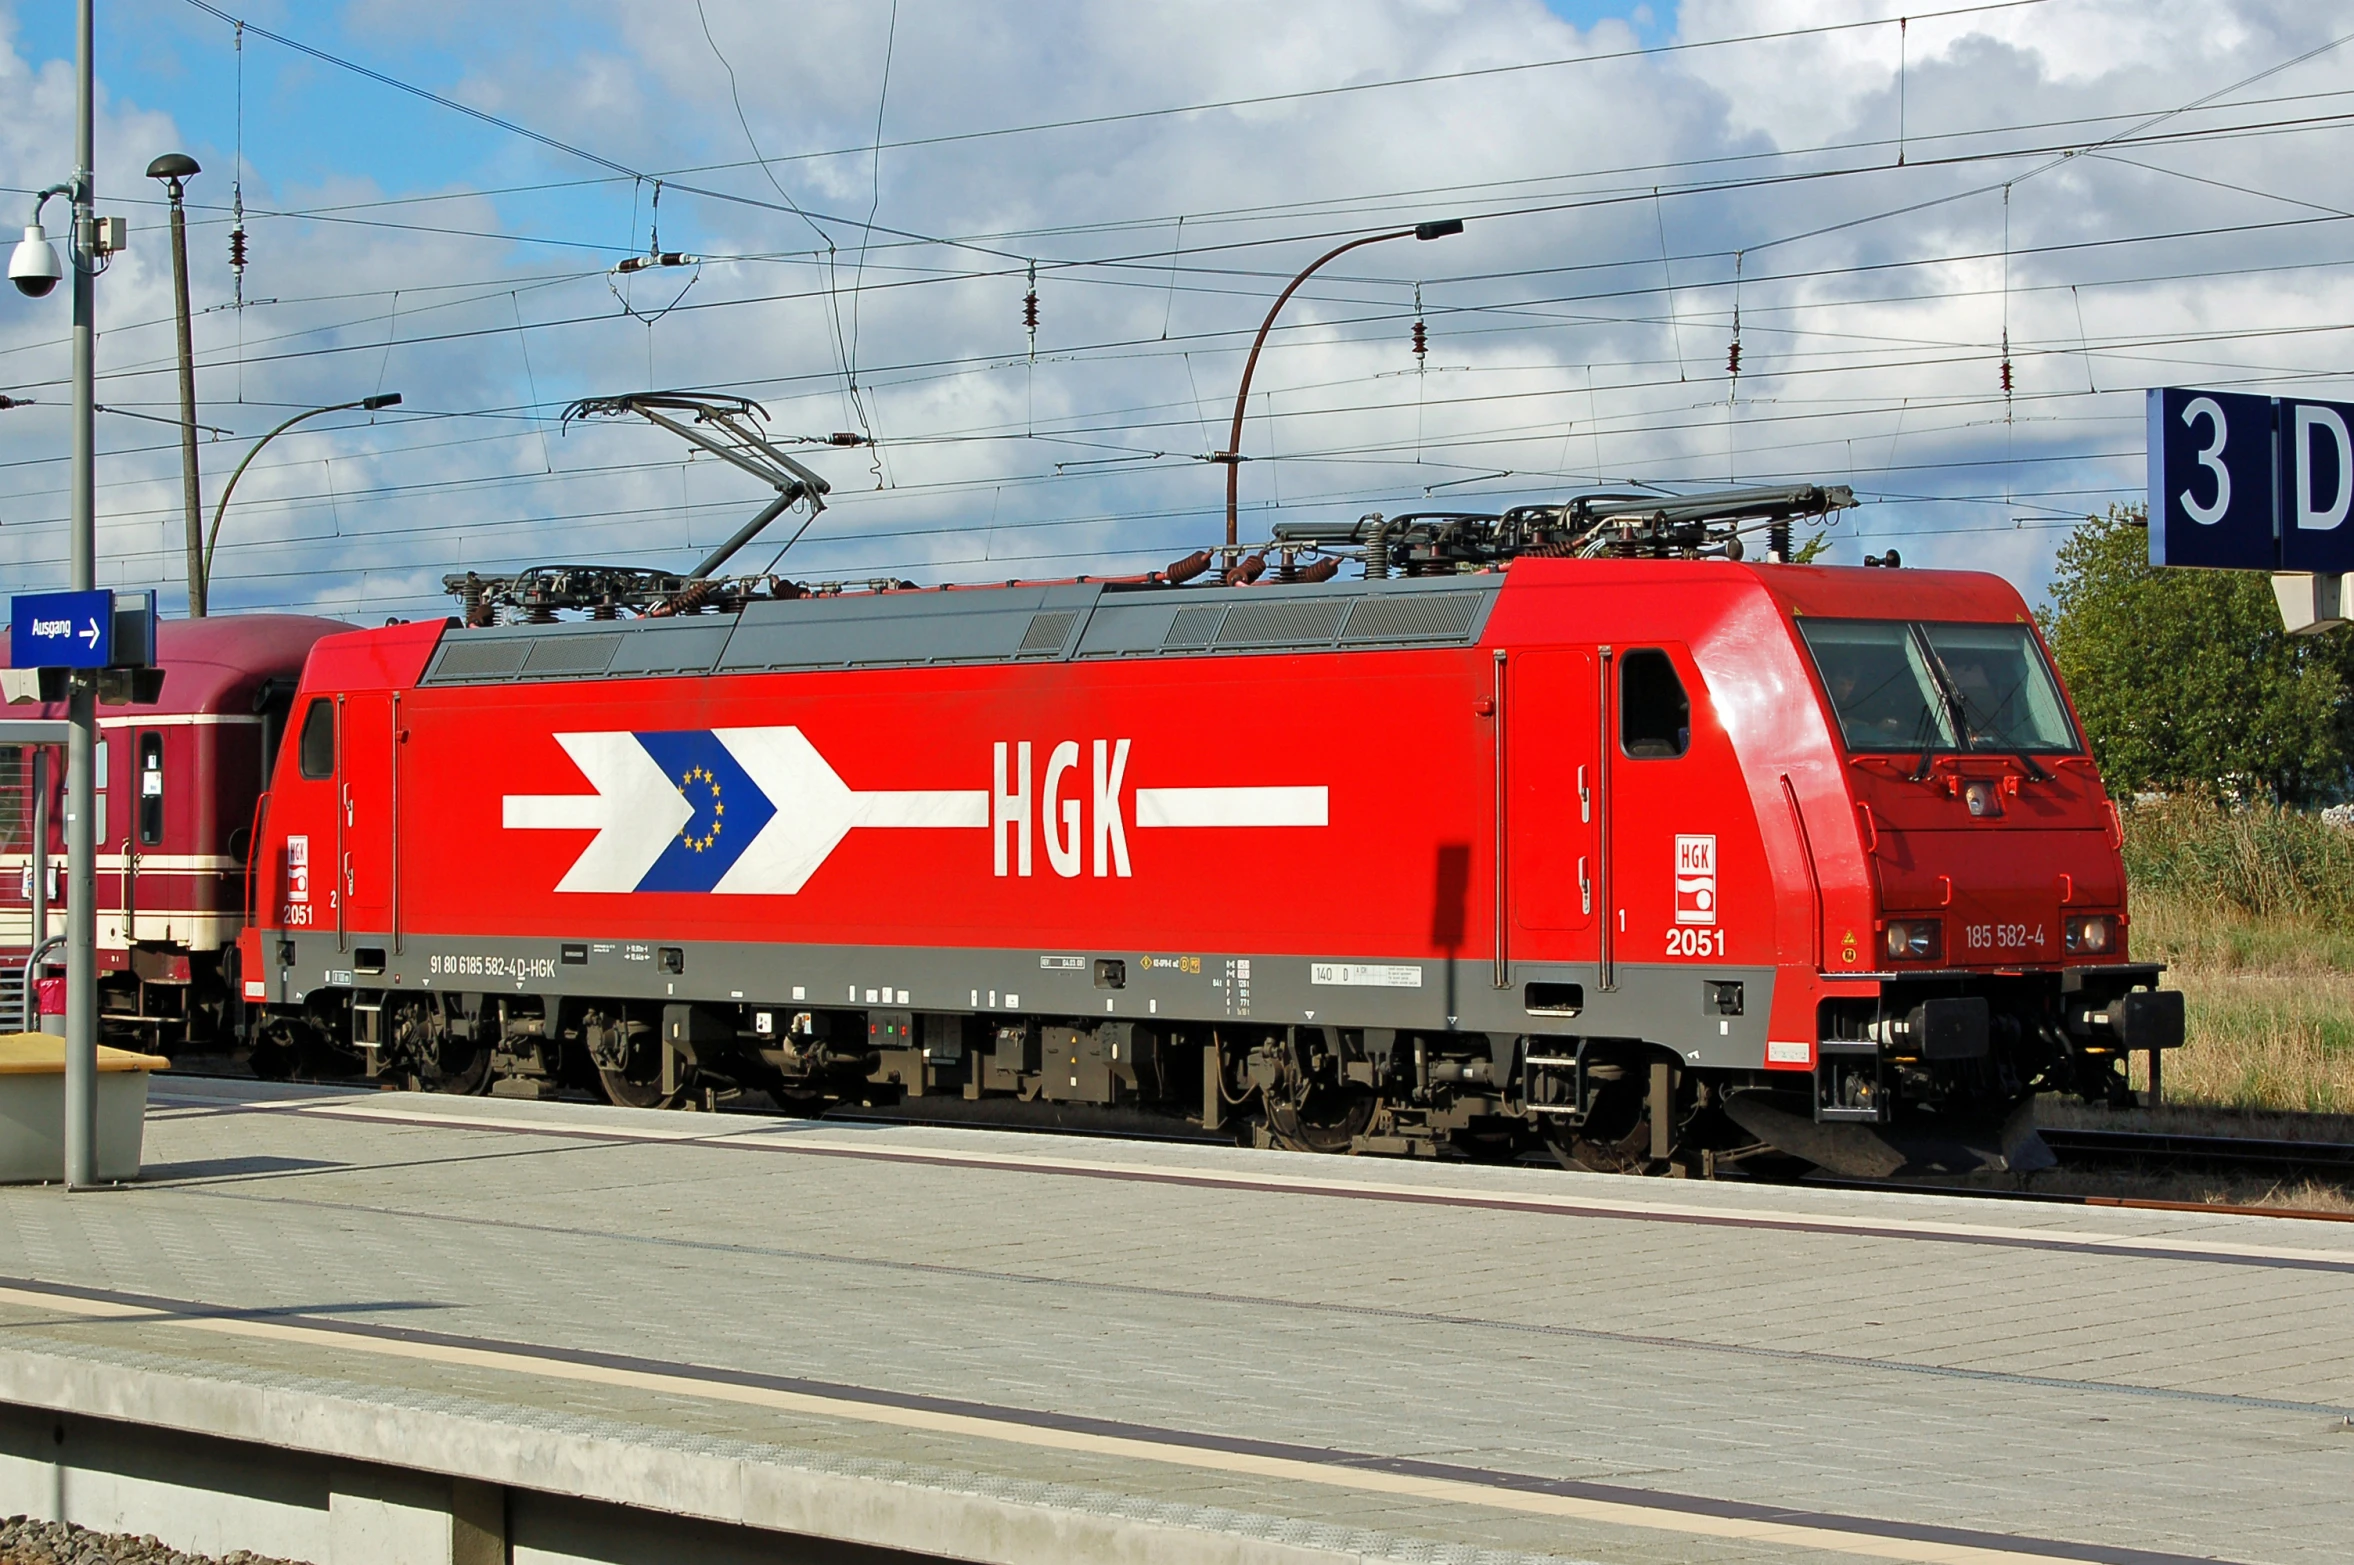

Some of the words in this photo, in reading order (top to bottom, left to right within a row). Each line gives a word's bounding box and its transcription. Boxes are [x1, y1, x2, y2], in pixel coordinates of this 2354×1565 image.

[2179, 396, 2231, 525] 3
[2295, 404, 2354, 531] D
[31, 618, 71, 639] Ausgang
[992, 738, 1132, 877] HGK
[290, 842, 305, 862] HGK
[1681, 844, 1709, 869] HGK
[330, 890, 337, 908] 2
[283, 904, 313, 925] 2051
[1618, 908, 1626, 932] 1
[1665, 928, 1725, 956] 2051
[1965, 924, 1992, 948] 185
[1997, 923, 2045, 947] 582-4
[430, 955, 442, 974] 91
[443, 955, 457, 974] 80
[458, 956, 483, 975] 6185
[485, 956, 517, 976] 582-4
[517, 958, 556, 979] D-HGK
[1316, 967, 1332, 981] 140
[1343, 968, 1349, 981] D
